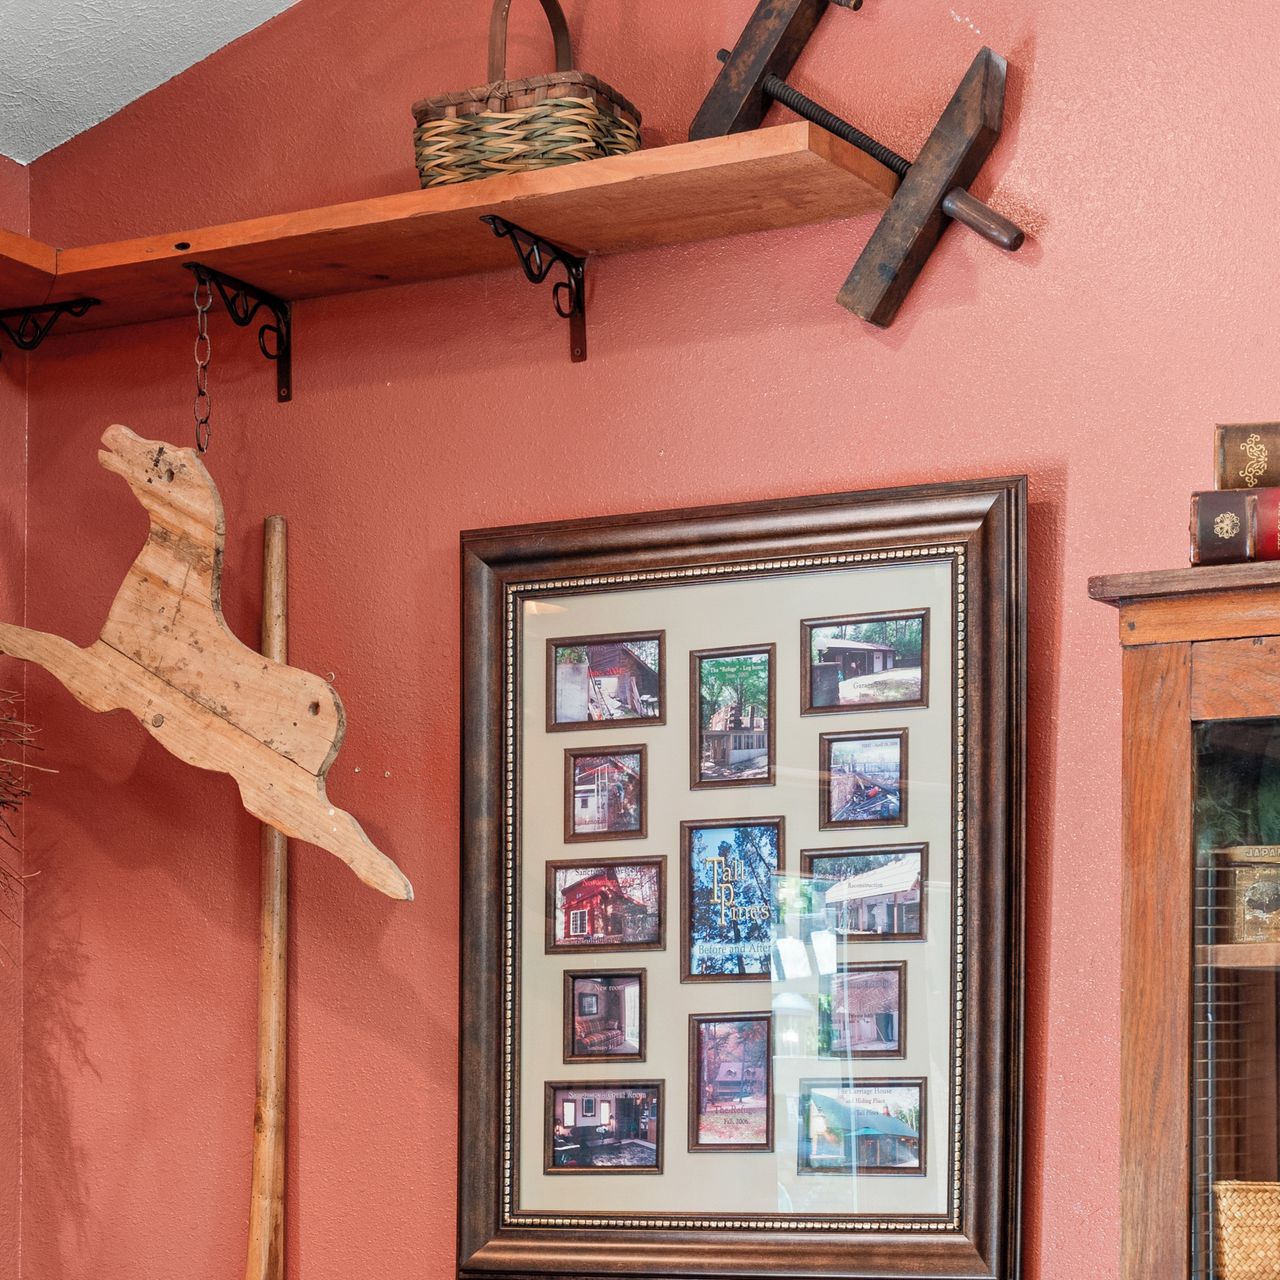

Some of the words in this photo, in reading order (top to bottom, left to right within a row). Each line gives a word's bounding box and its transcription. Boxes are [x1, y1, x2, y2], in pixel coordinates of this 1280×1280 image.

[704, 856, 747, 904] Tall
[718, 883, 771, 928] Pines
[698, 944, 727, 955] Before
[729, 943, 746, 953] and
[748, 942, 772, 953] After
[593, 983, 608, 991] New
